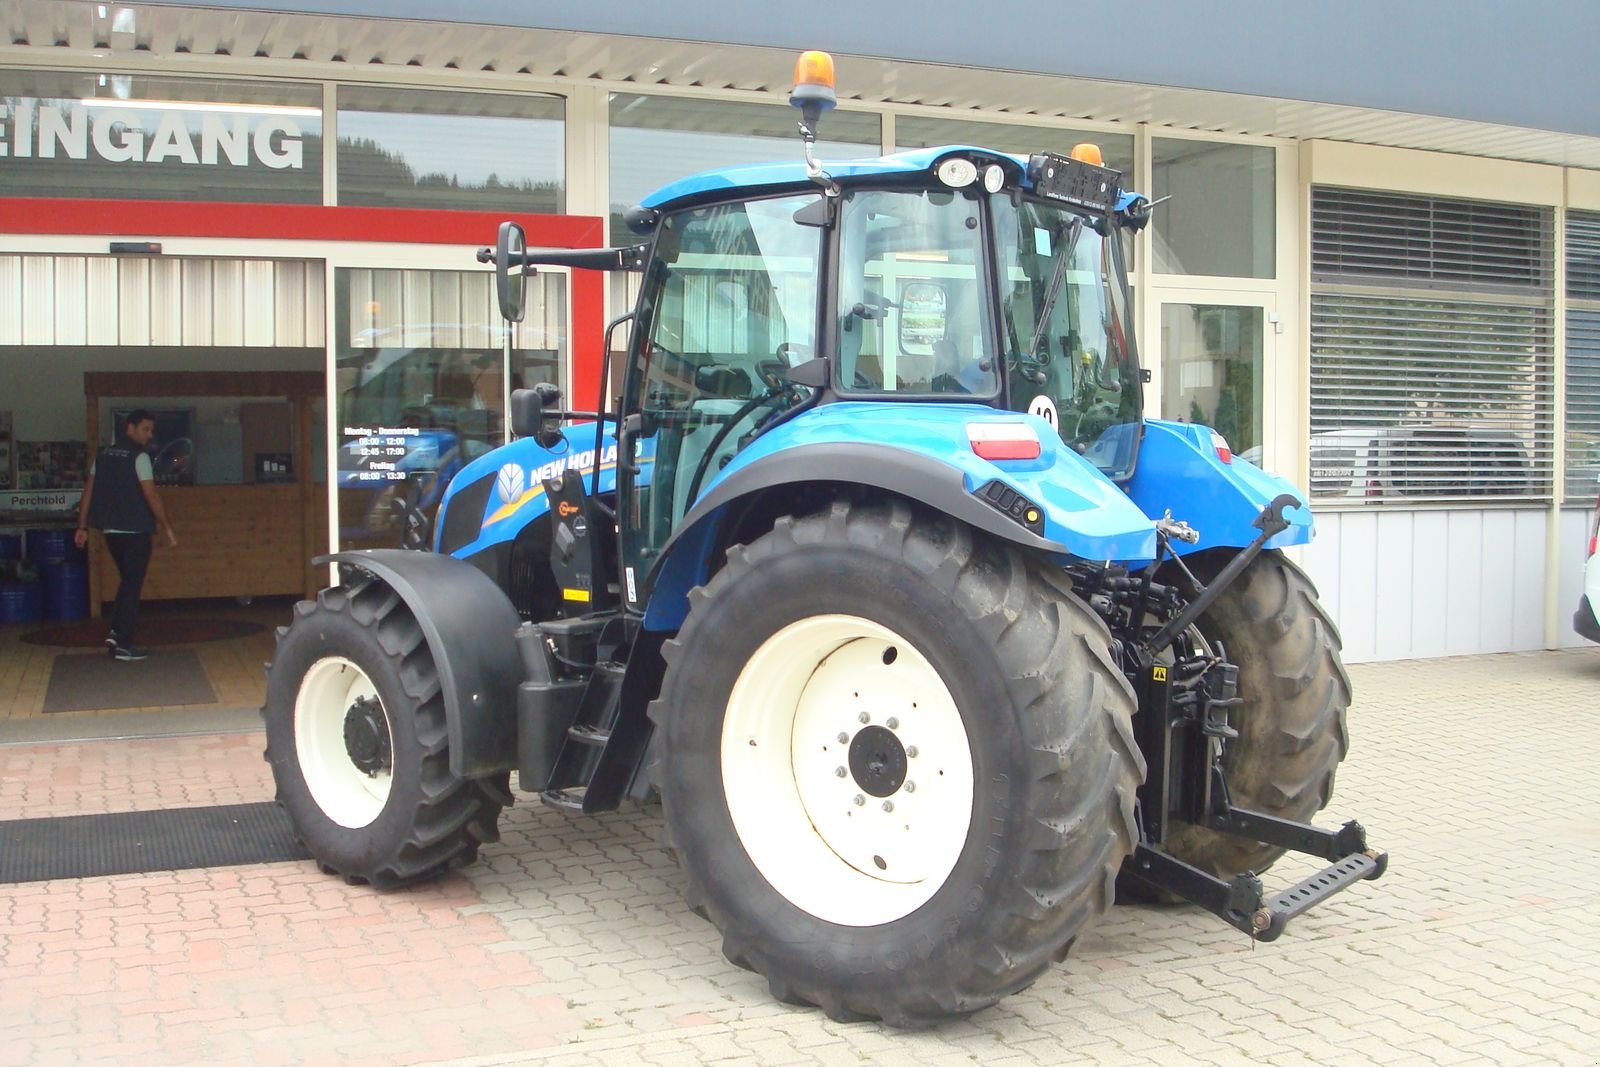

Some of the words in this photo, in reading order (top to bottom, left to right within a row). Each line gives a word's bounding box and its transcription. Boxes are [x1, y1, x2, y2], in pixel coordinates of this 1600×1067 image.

[0, 104, 303, 169] INGANG
[360, 448, 380, 456] 12:45
[386, 448, 405, 456] 17:00
[530, 458, 567, 487] NEW
[567, 441, 643, 470] HOLLAD
[11, 495, 66, 505] Perchtold
